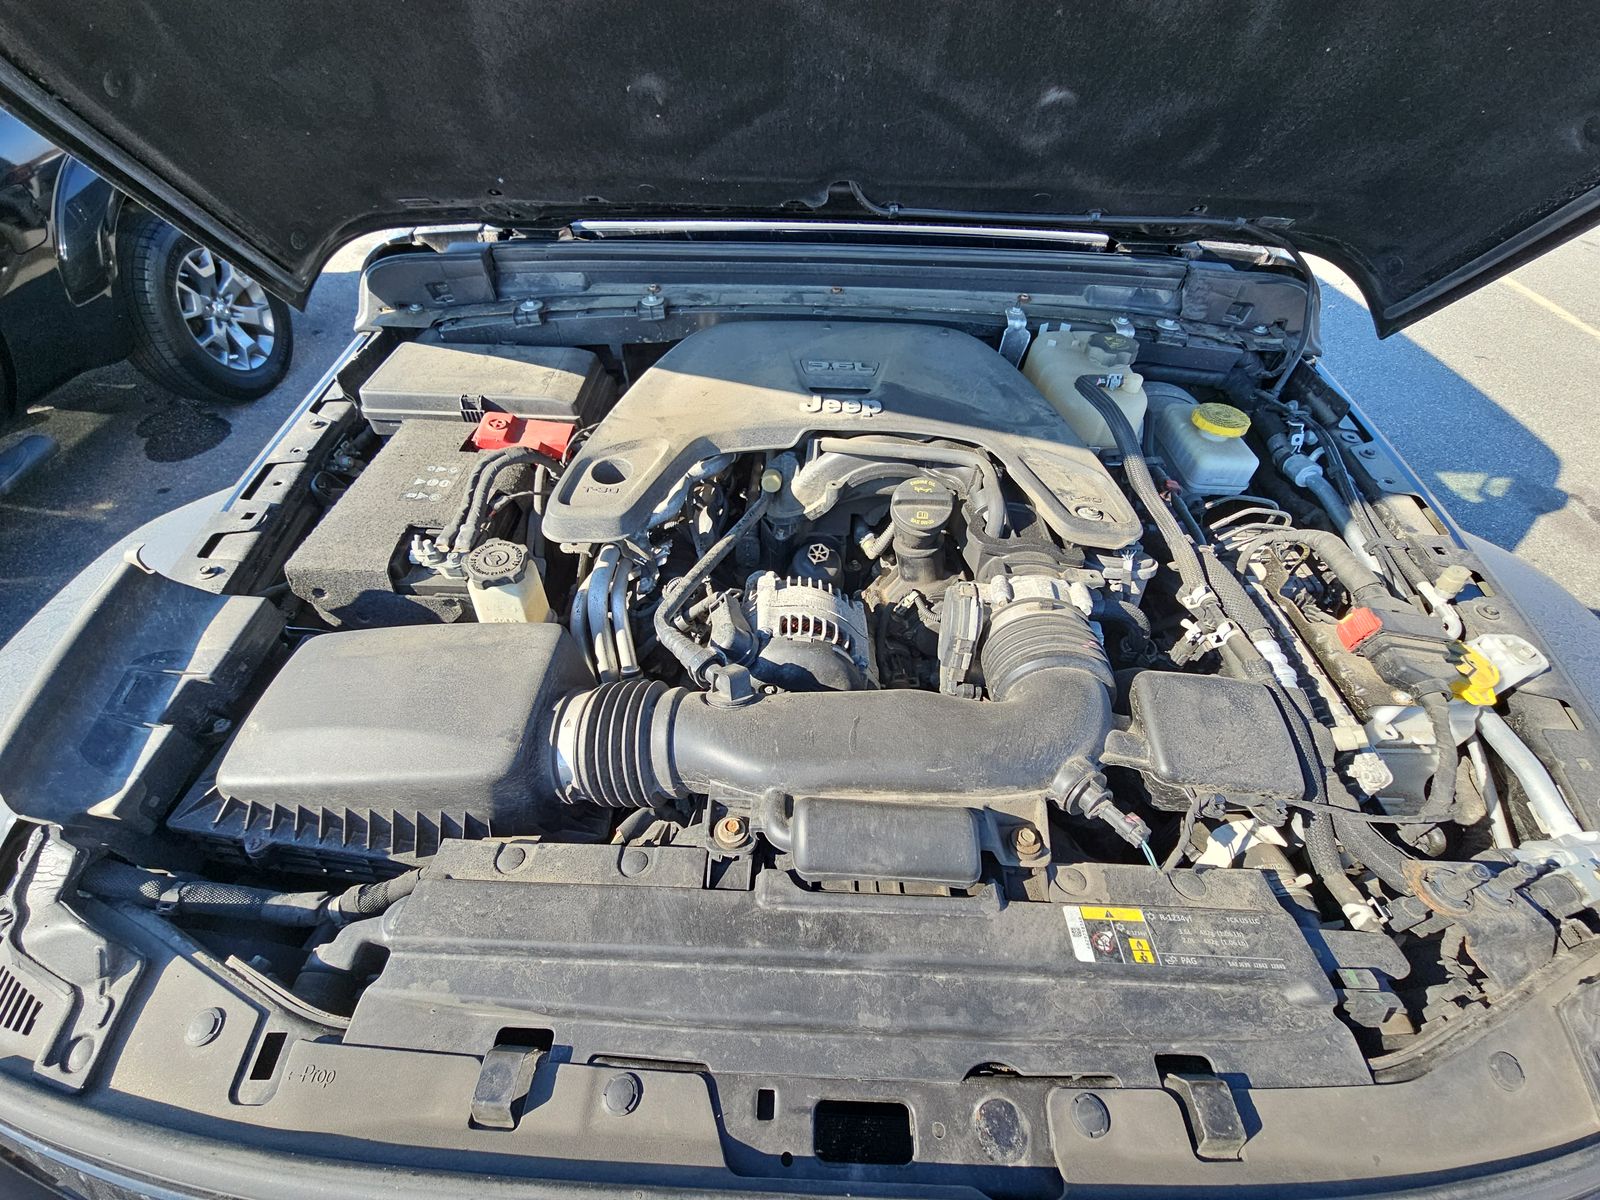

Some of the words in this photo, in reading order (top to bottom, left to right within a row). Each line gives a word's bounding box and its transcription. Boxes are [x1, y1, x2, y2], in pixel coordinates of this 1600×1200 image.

[806, 360, 875, 374] 3.6L
[800, 396, 882, 417] Jeep
[1180, 956, 1198, 965] PAG
[301, 1064, 336, 1088] Prop
